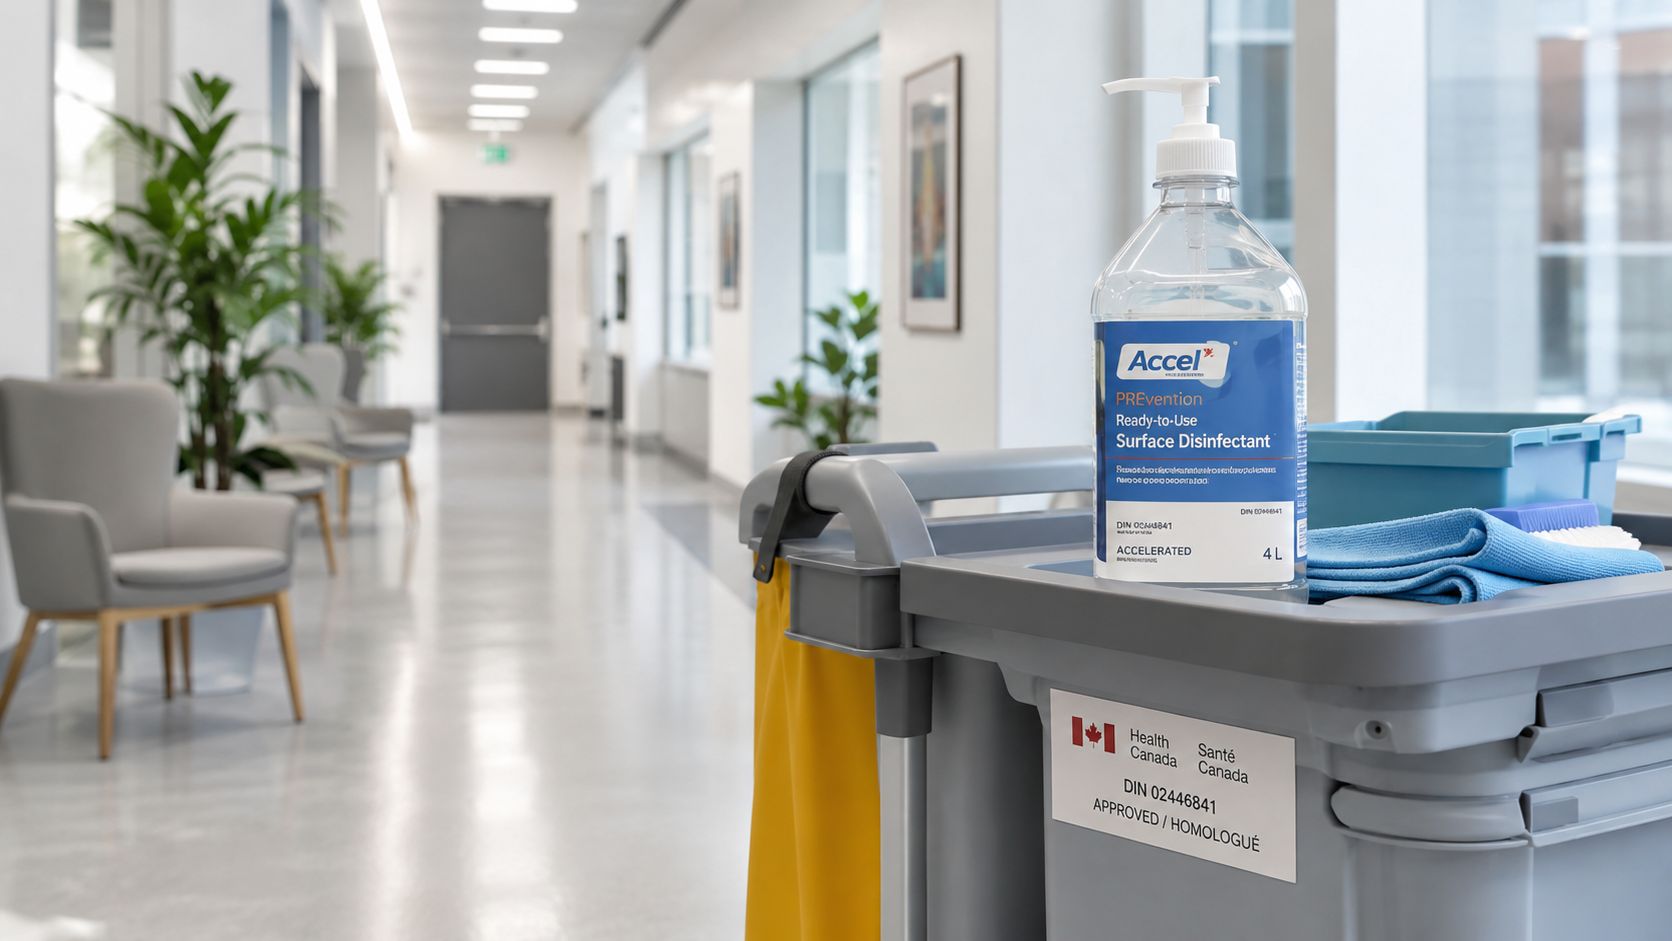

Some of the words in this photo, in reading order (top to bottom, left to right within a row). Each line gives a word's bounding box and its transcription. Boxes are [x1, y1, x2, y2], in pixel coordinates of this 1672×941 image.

[1128, 350, 1201, 370] Accel
[1116, 392, 1203, 406] PREvention
[1116, 415, 1197, 428] Ready-to-Use
[1116, 434, 1174, 449] Surface
[1179, 434, 1270, 449] Disinfectant
[1116, 521, 1132, 529] DIN
[1116, 545, 1191, 557] ACCELERATED
[1263, 548, 1271, 559] 4
[1275, 547, 1283, 560] L
[1130, 729, 1169, 749] Health
[1130, 746, 1177, 768] Canada
[1198, 743, 1235, 764] Santé
[1198, 761, 1249, 784] Canada
[1124, 779, 1147, 797] DIN
[1151, 785, 1216, 814] 02446841
[1093, 798, 1159, 826] APPROVED
[1163, 815, 1167, 828] /
[1171, 817, 1260, 853] HOMOLOGUÉ
